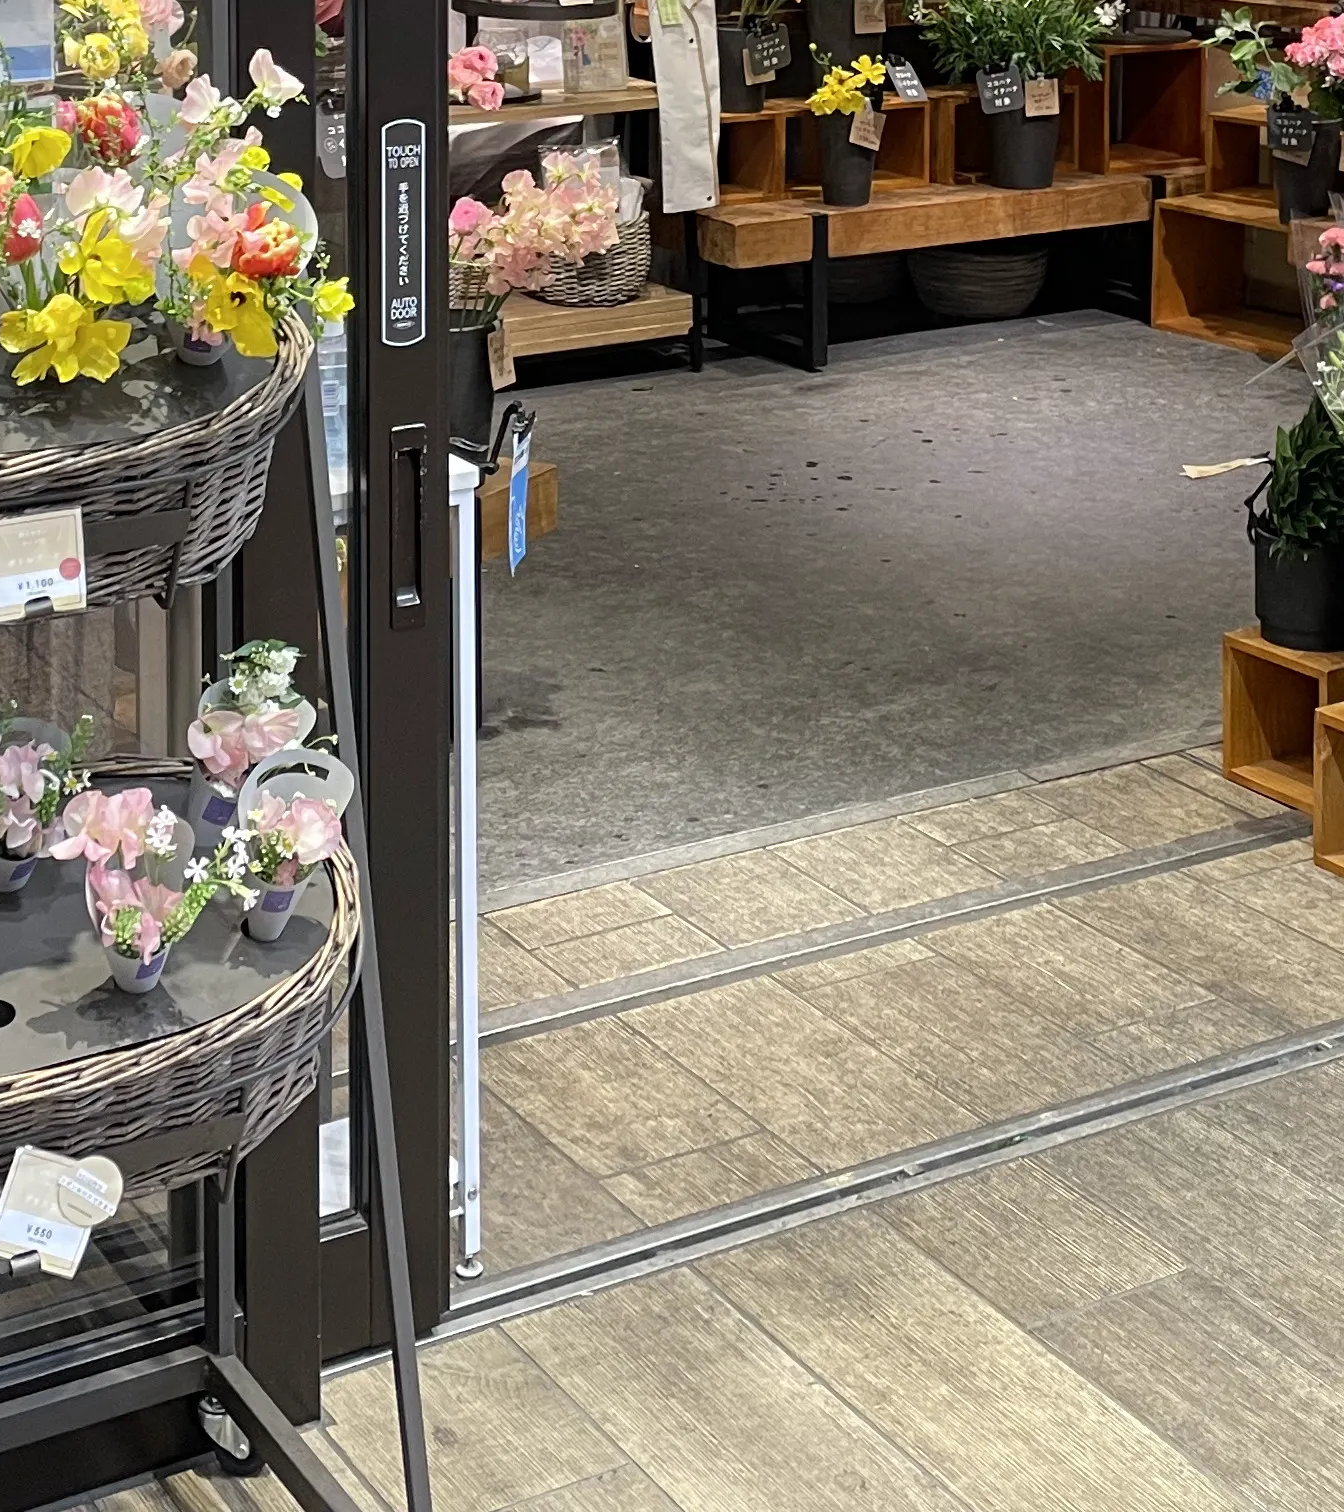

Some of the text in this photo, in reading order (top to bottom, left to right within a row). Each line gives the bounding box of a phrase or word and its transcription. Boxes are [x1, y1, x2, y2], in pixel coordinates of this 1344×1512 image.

[386, 144, 421, 158] TOUCH
[388, 155, 420, 170] TO OPEN
[391, 296, 418, 309] AUTO
[390, 307, 418, 321] DOOR
